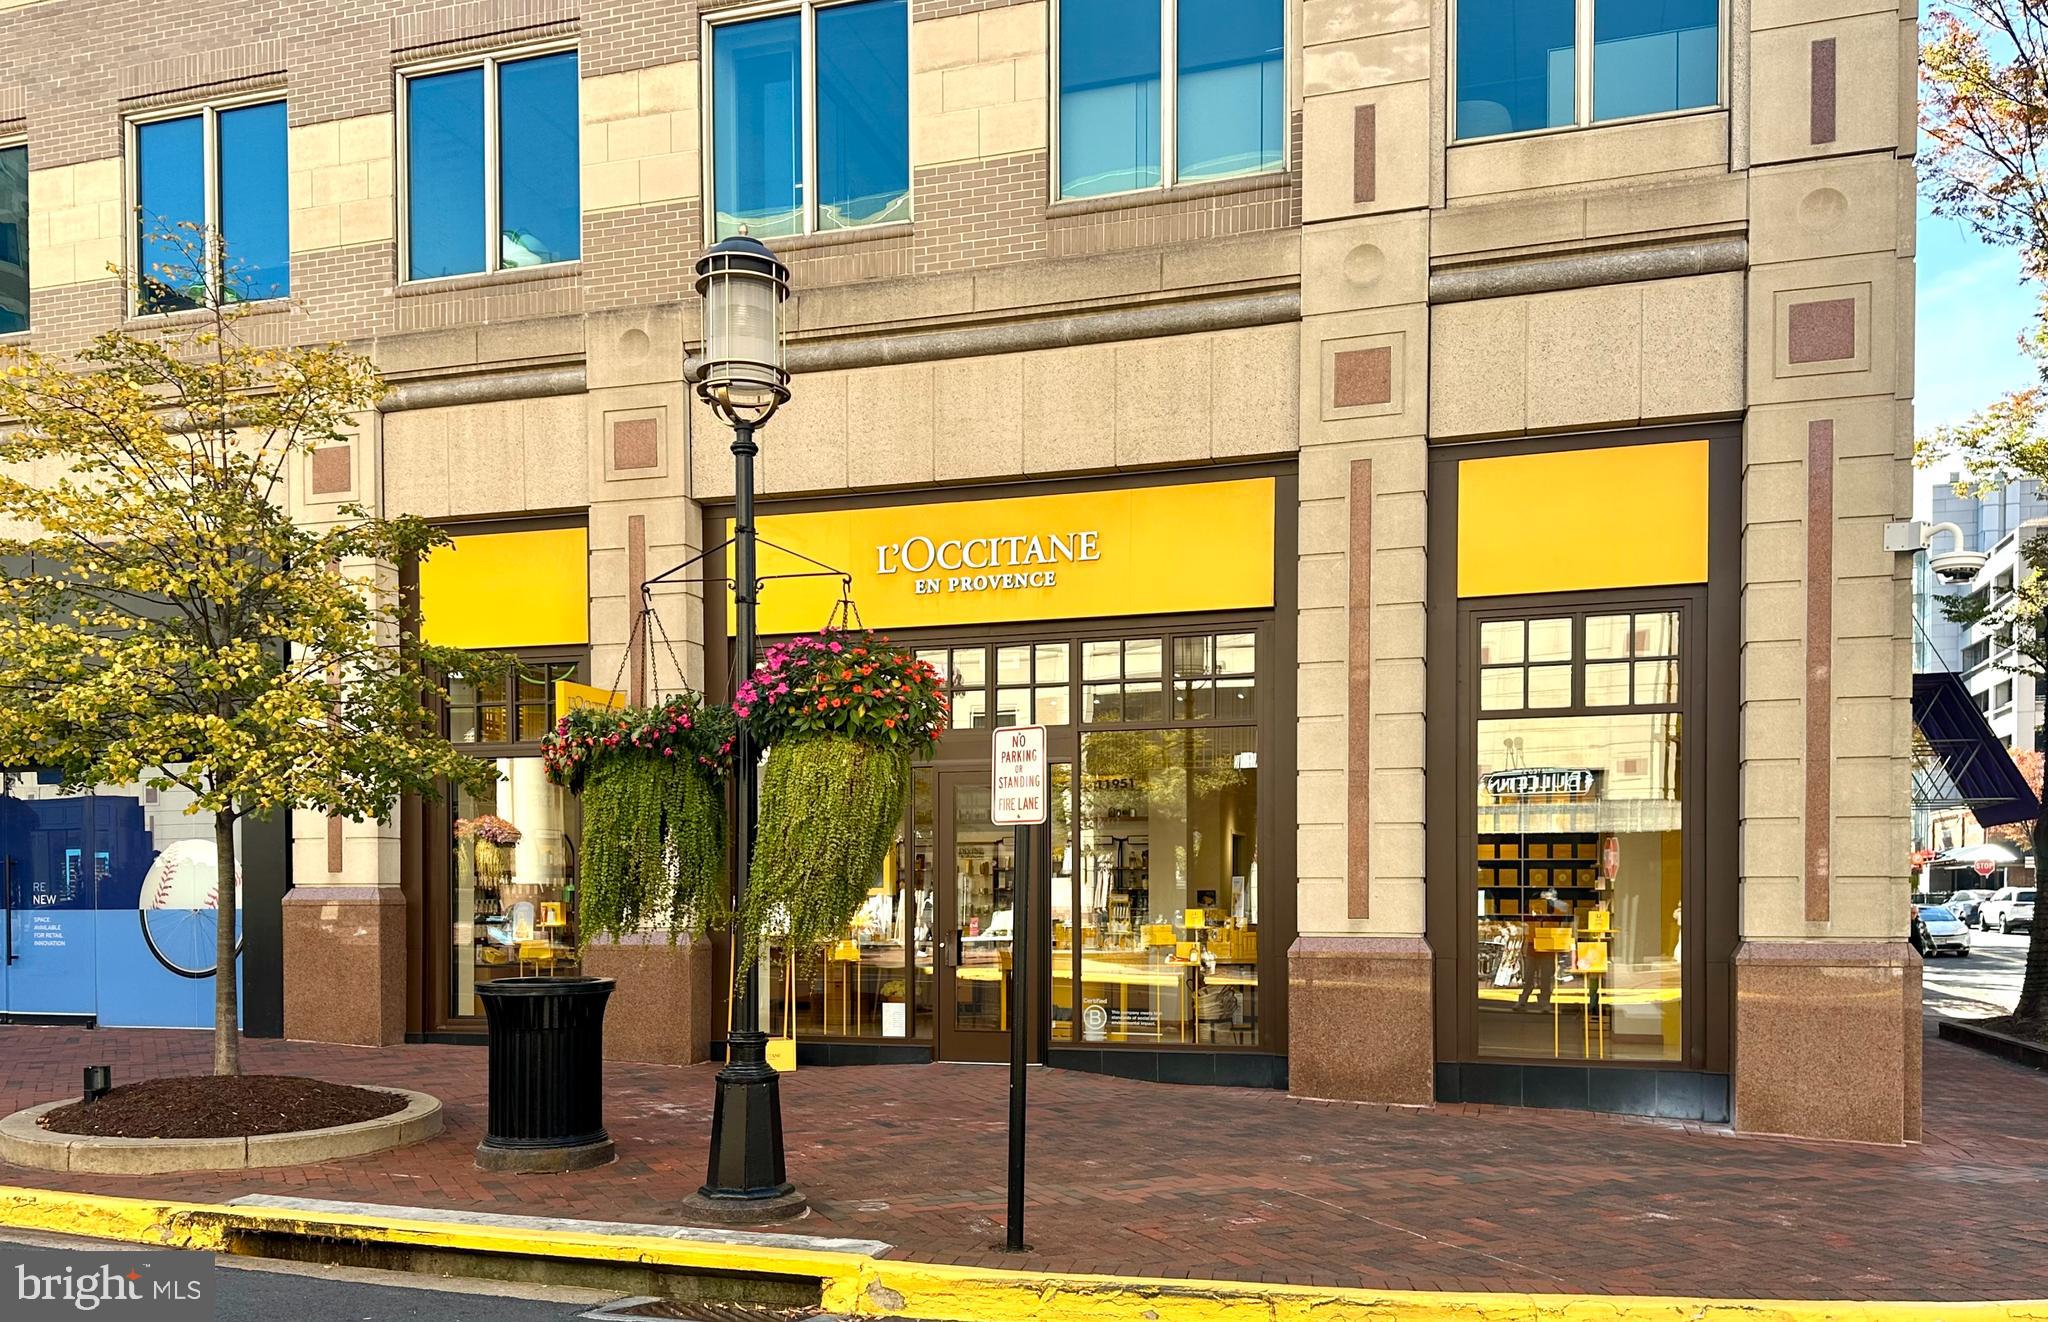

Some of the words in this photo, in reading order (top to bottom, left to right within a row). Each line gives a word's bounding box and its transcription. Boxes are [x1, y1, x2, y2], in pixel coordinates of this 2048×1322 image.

[876, 530, 1101, 574] L'OCCITANE
[914, 578, 940, 594] EN
[948, 571, 1056, 593] PROVENCE
[1012, 735, 1026, 748] NO
[1001, 749, 1037, 763] PARKING
[1015, 765, 1023, 773] OR
[999, 775, 1040, 789] STANDING
[999, 797, 1015, 811] FIRE
[1018, 796, 1039, 810] LANE
[33, 882, 46, 892] RE
[33, 895, 56, 905] NEW
